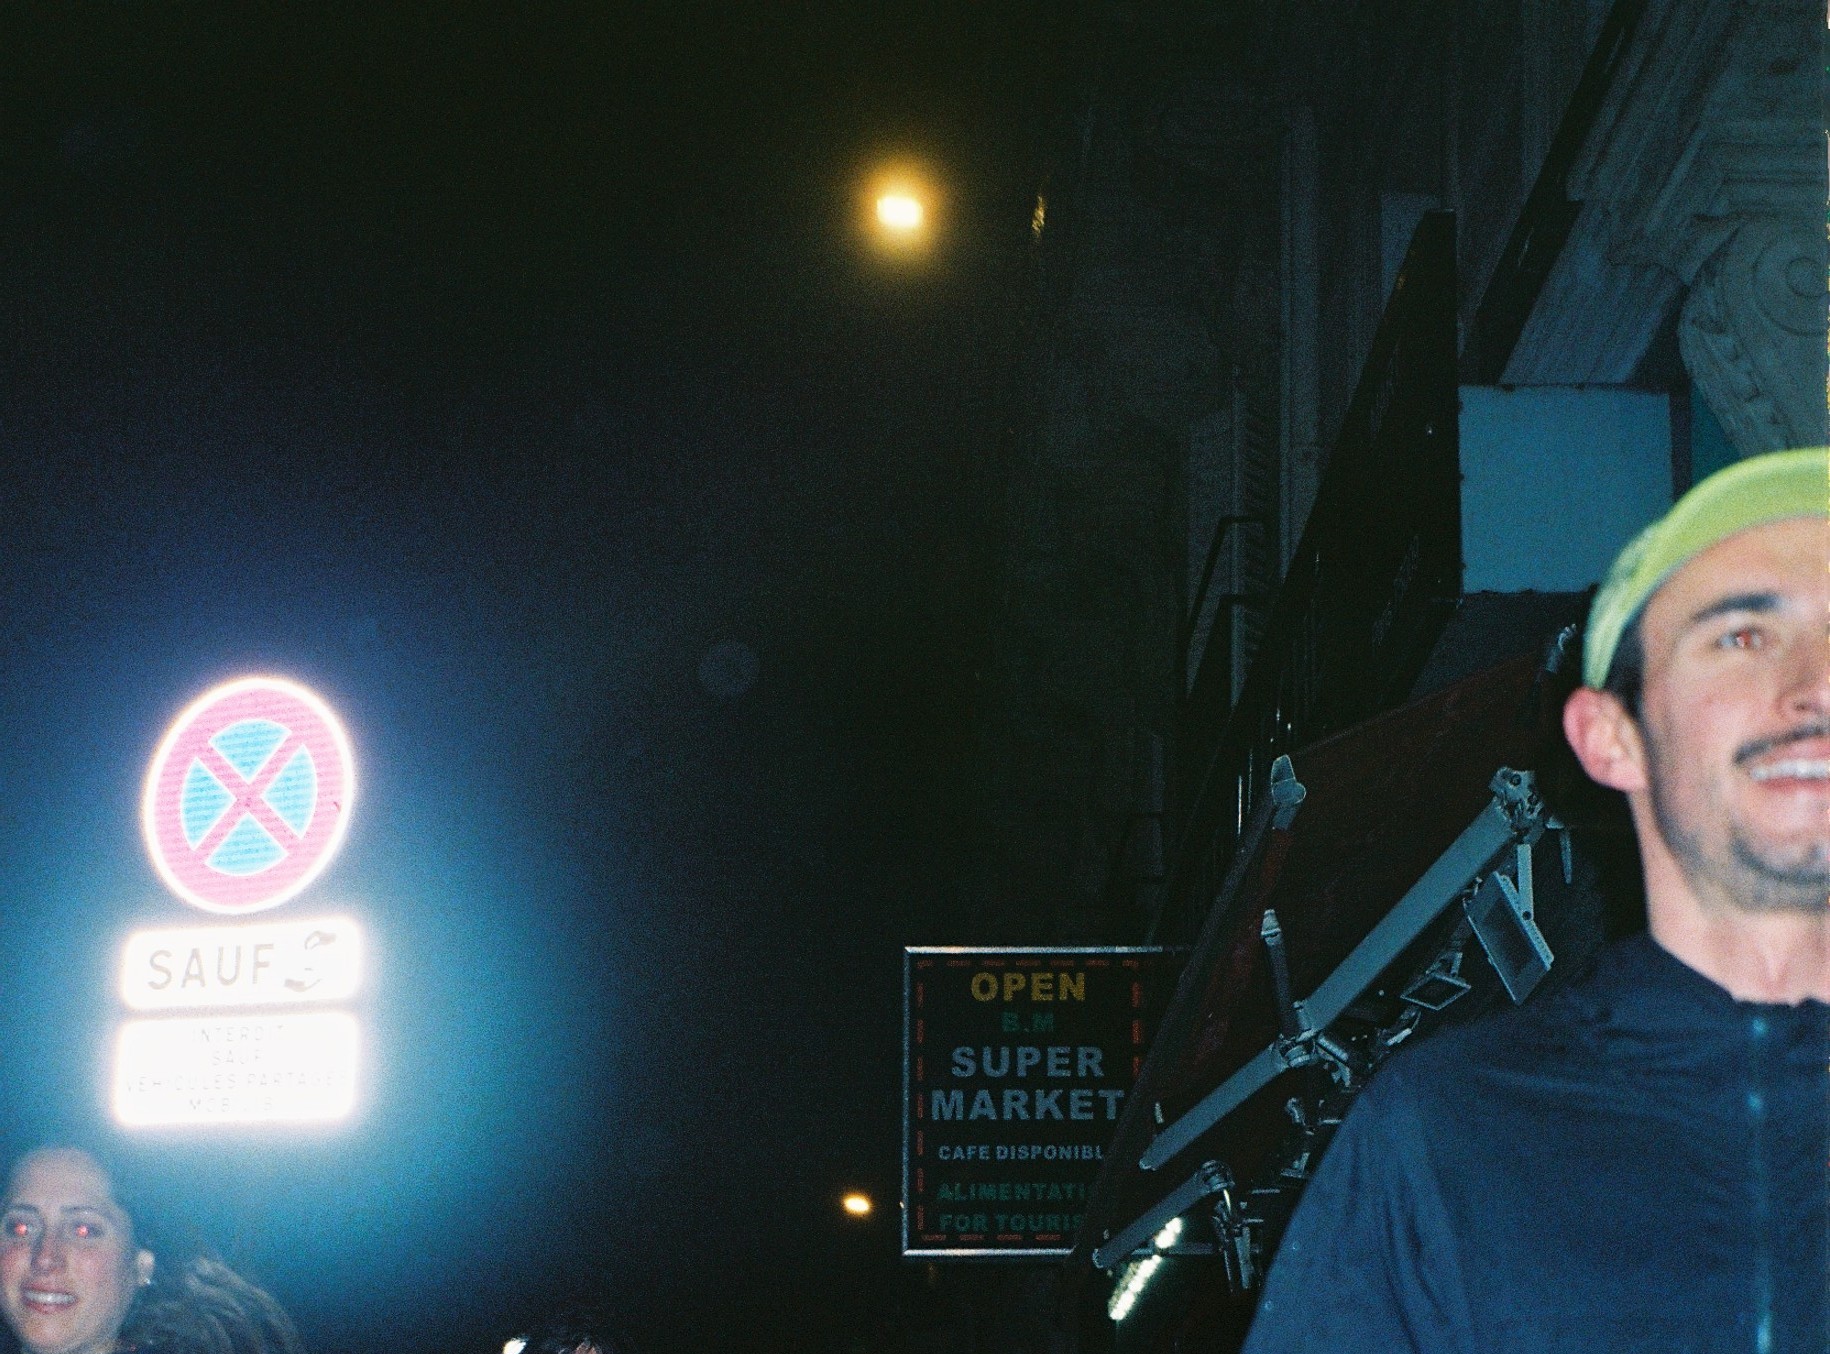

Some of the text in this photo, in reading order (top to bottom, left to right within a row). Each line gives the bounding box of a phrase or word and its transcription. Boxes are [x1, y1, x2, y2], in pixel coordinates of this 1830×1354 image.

[147, 943, 274, 990] SAUF
[970, 972, 1086, 1001] OPEN
[951, 1046, 1105, 1078] SUPER
[931, 1088, 1125, 1121] MARKET
[938, 1145, 990, 1161] CAFE
[938, 1213, 989, 1232] FOR
